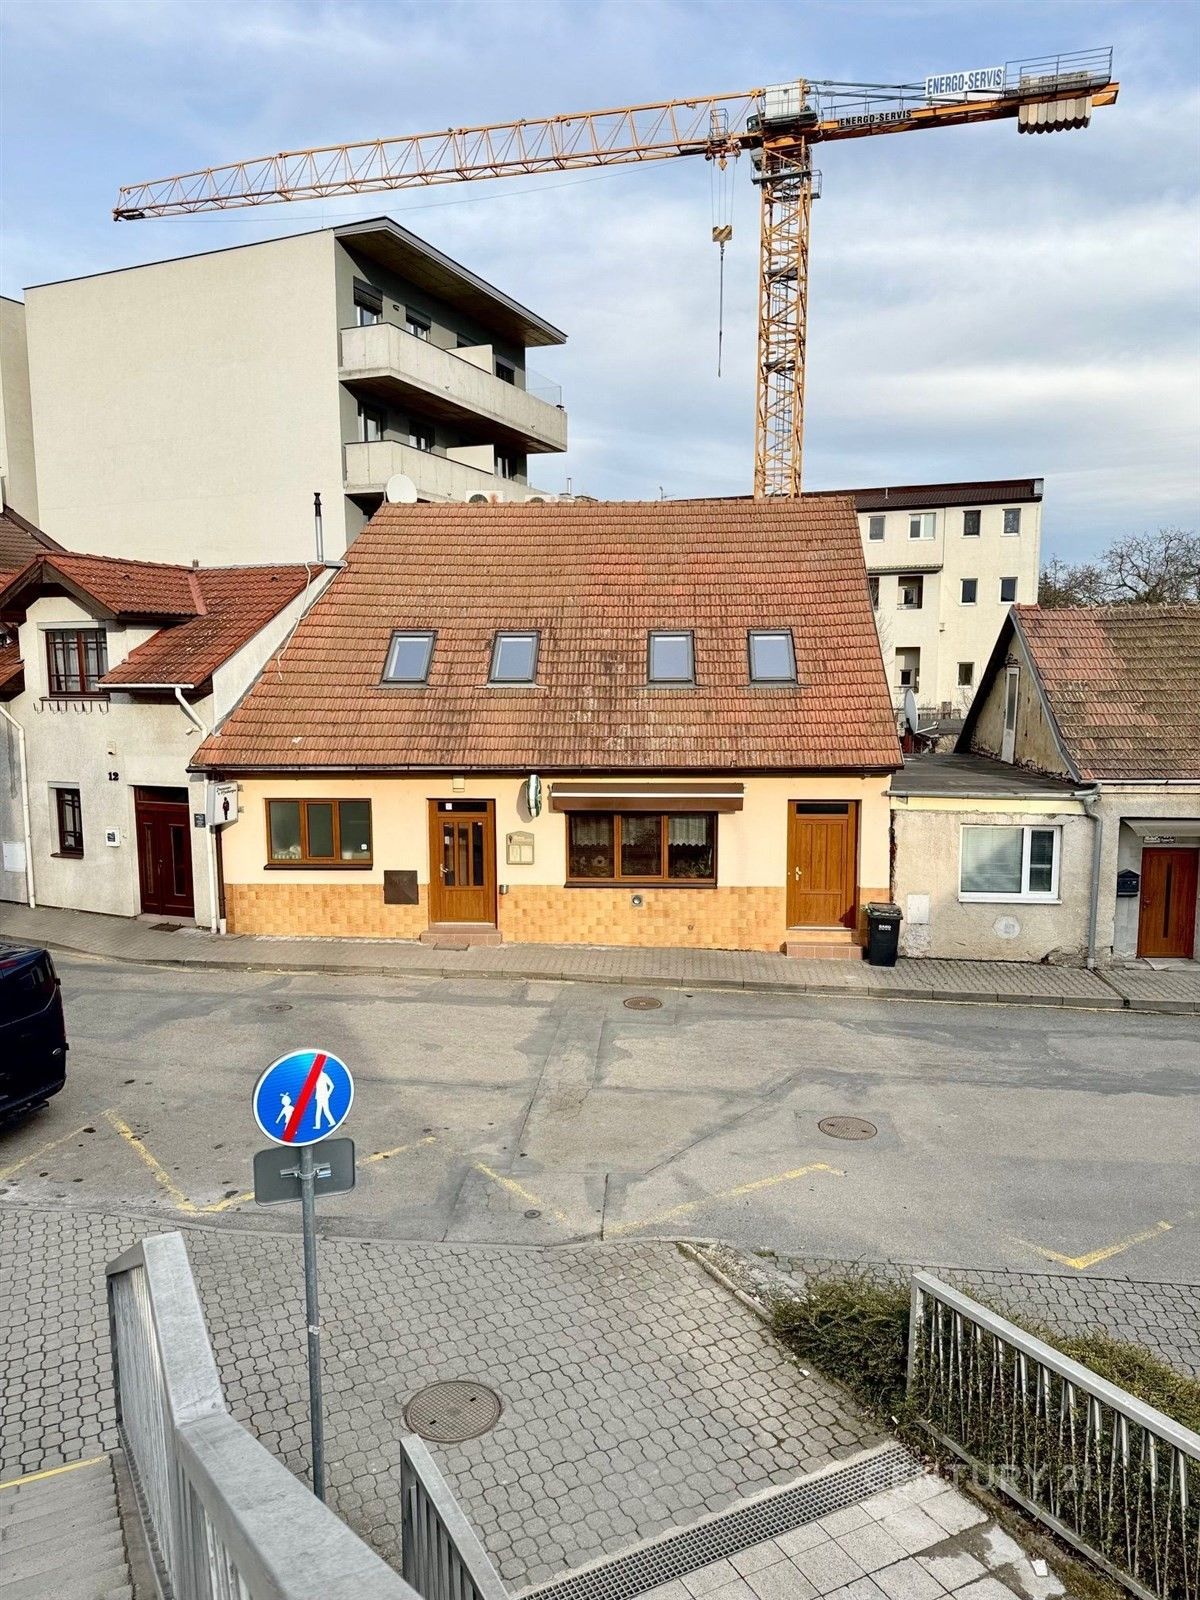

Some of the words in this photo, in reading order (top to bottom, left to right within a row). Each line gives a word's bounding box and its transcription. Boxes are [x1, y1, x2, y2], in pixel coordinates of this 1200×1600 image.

[927, 69, 1003, 95] ENERGO-SERVIS
[839, 110, 912, 127] ENERGO-SERVIS
[108, 772, 119, 782] 12
